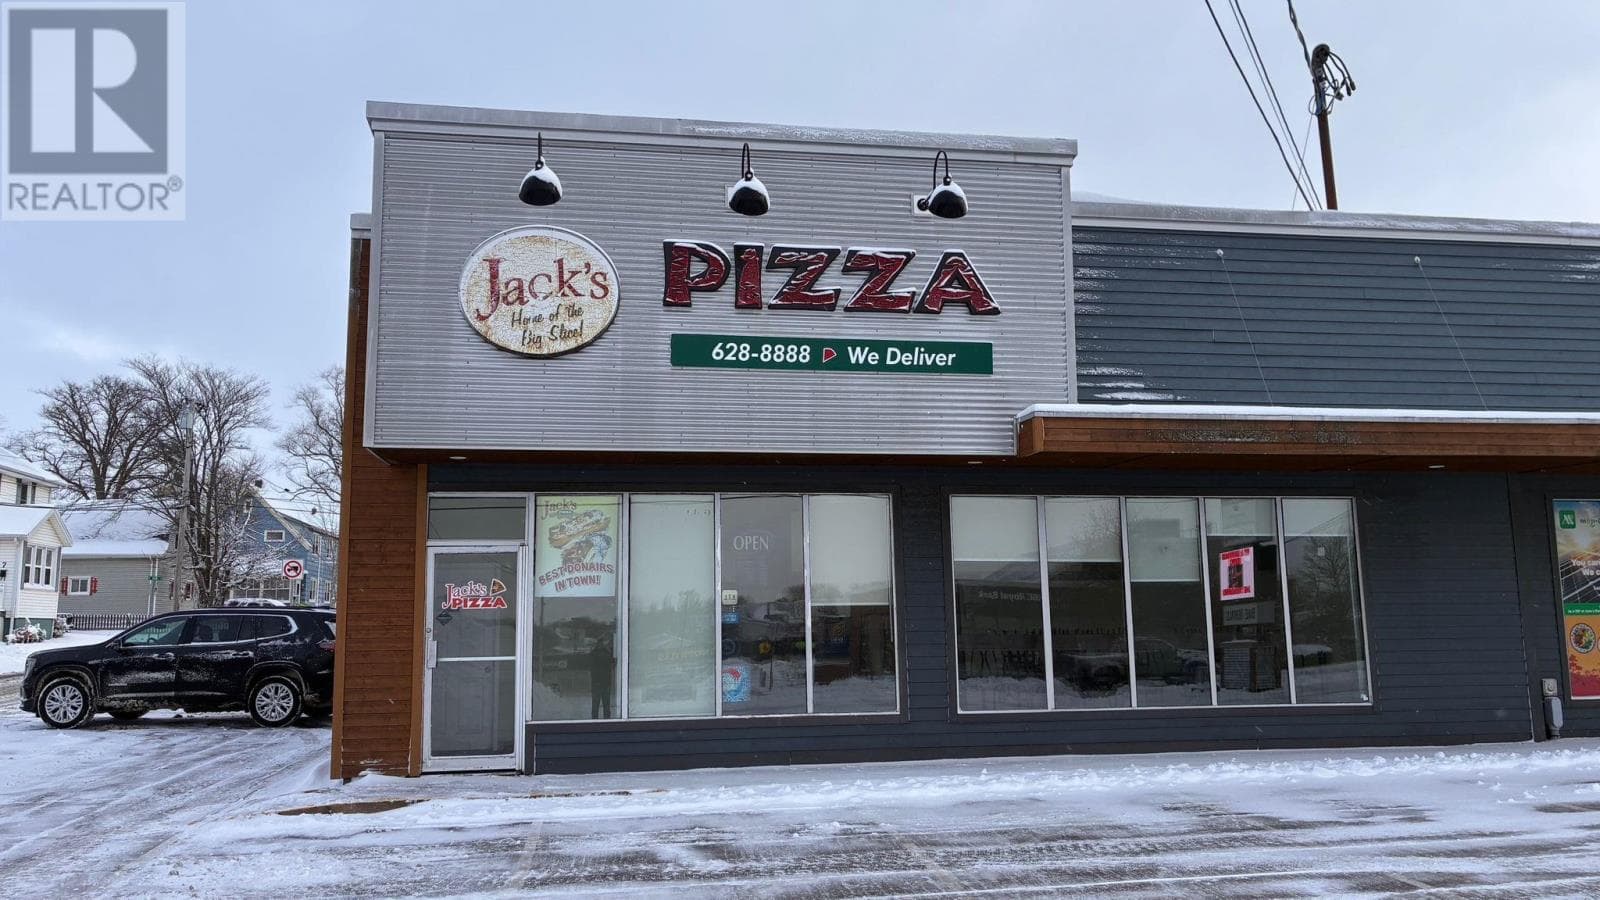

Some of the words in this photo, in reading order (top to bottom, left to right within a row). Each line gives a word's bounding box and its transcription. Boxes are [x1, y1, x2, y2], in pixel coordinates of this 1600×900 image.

[662, 238, 1001, 315] PIZZA
[475, 257, 610, 322] Jack's
[511, 308, 544, 328] Home
[549, 303, 561, 323] of
[565, 302, 584, 319] the
[521, 329, 543, 350] Big
[711, 342, 811, 364] 628-8888
[847, 346, 879, 365] We
[885, 347, 956, 367] Deliver
[733, 535, 769, 551] OPEN
[538, 566, 567, 586] BEST
[567, 561, 615, 575] DONAIRS
[1570, 558, 1586, 567] You
[442, 580, 488, 609] Jack's
[554, 580, 567, 593] IN
[451, 596, 507, 610] PIZZA
